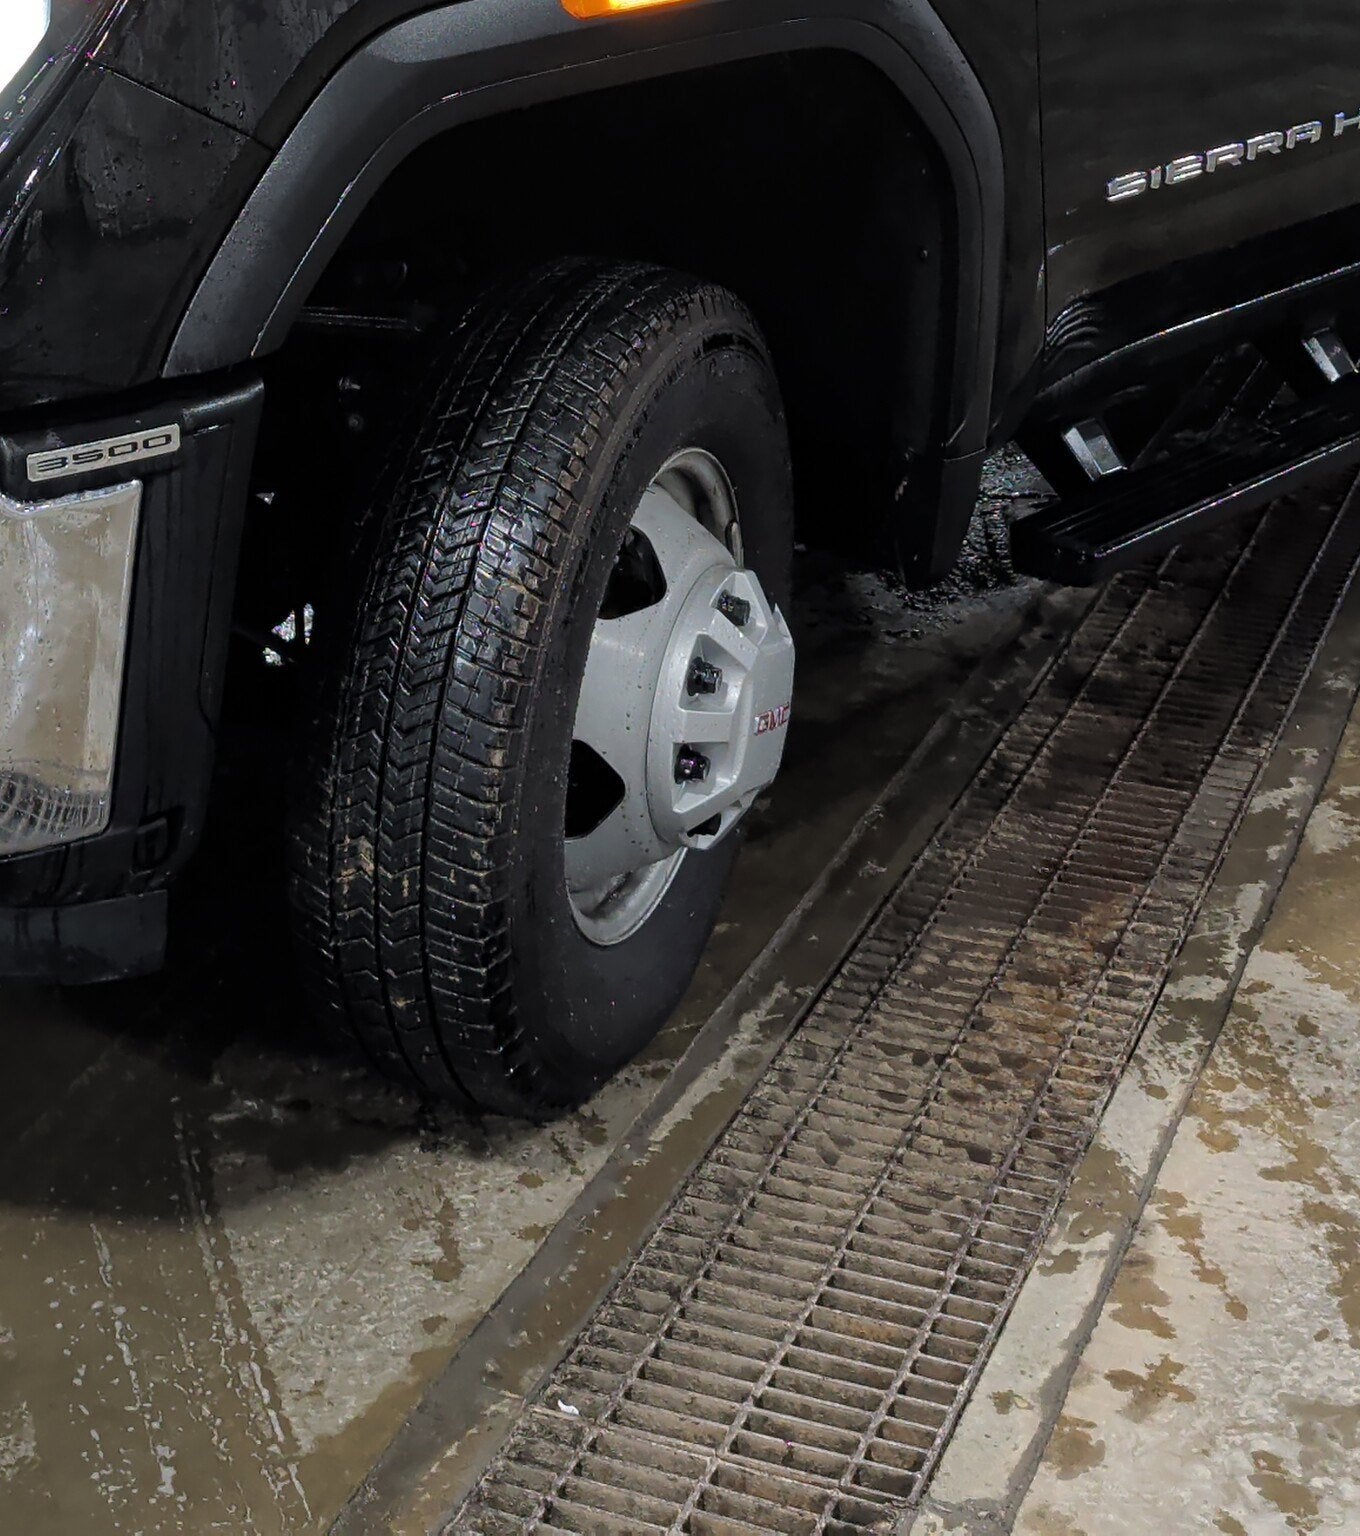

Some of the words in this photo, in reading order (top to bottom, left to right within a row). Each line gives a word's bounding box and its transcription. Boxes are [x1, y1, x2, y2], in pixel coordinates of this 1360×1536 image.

[1105, 120, 1323, 203] SIERRA
[36, 433, 173, 473] 3500
[753, 701, 790, 736] GMC
